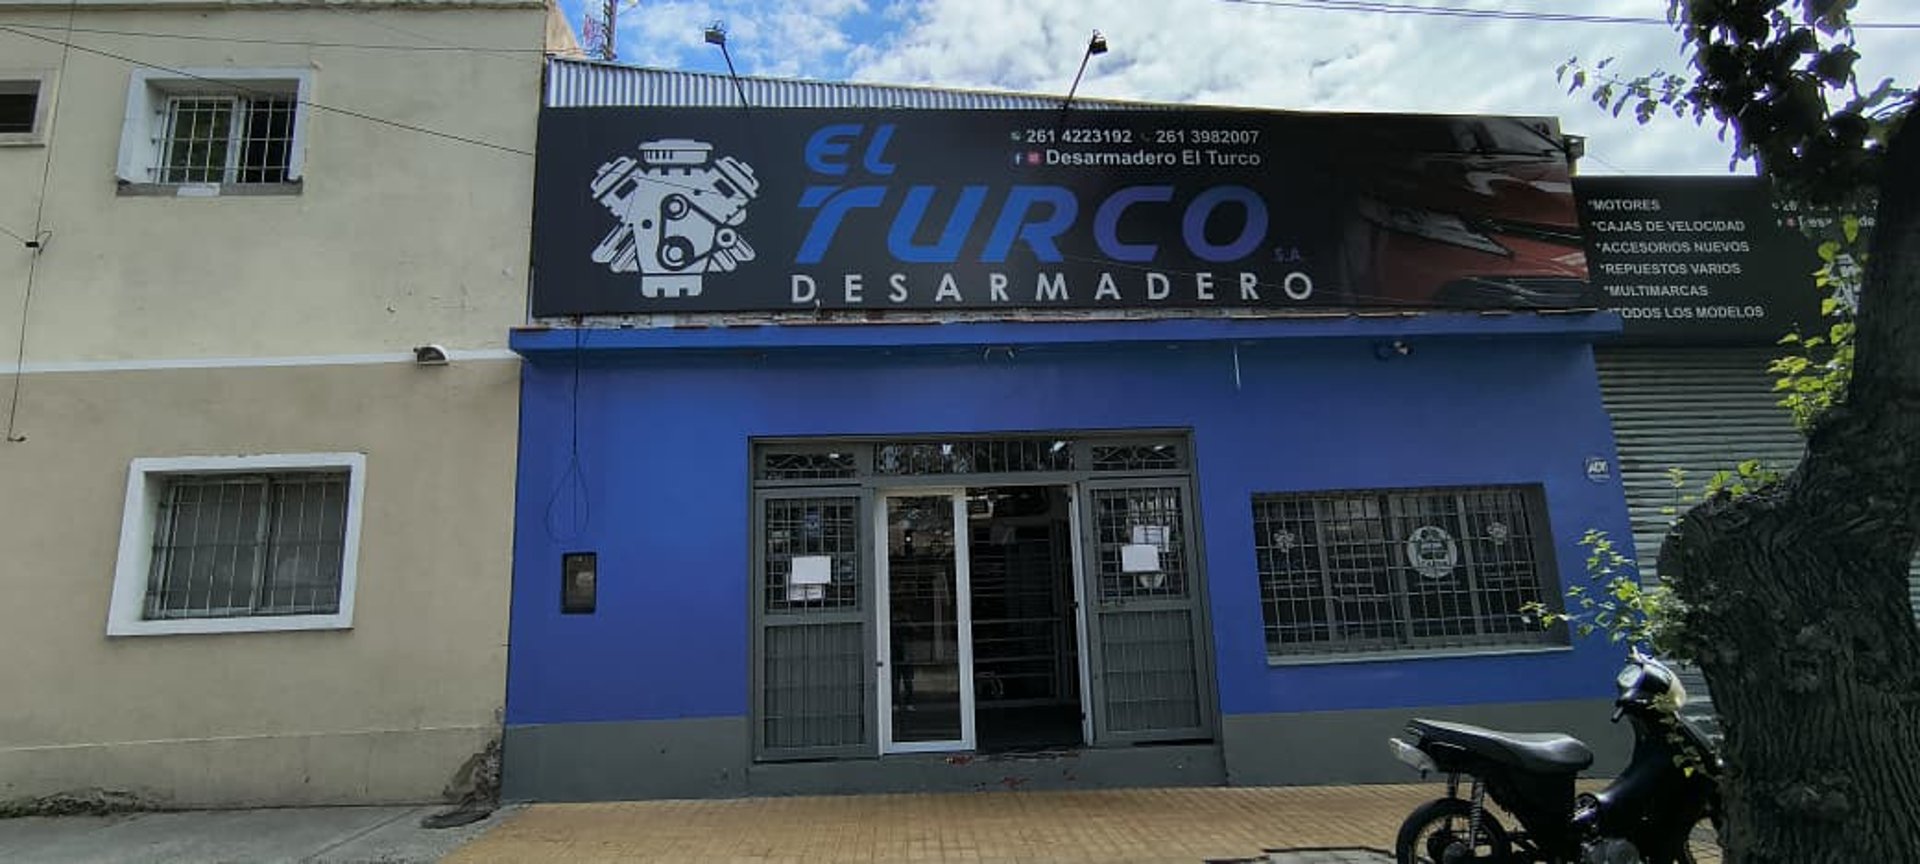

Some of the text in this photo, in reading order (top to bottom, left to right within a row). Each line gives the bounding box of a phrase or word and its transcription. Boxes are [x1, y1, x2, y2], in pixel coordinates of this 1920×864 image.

[1026, 130, 1260, 144] 261 4223192 261 3982007
[804, 124, 897, 175] EL
[1045, 149, 1177, 166] Desarmadero
[1182, 150, 1200, 166] El
[1204, 150, 1261, 167] Turco
[794, 184, 1270, 264] TURCO
[1646, 220, 1664, 232] DE
[1667, 219, 1746, 232] VELOCIDAD
[1694, 240, 1750, 253] NUEVOS
[1692, 262, 1742, 275] VARIOS
[790, 271, 1314, 303] DESARMADERO
[1665, 306, 1693, 319] LOS
[1696, 305, 1764, 318] MODELOS
